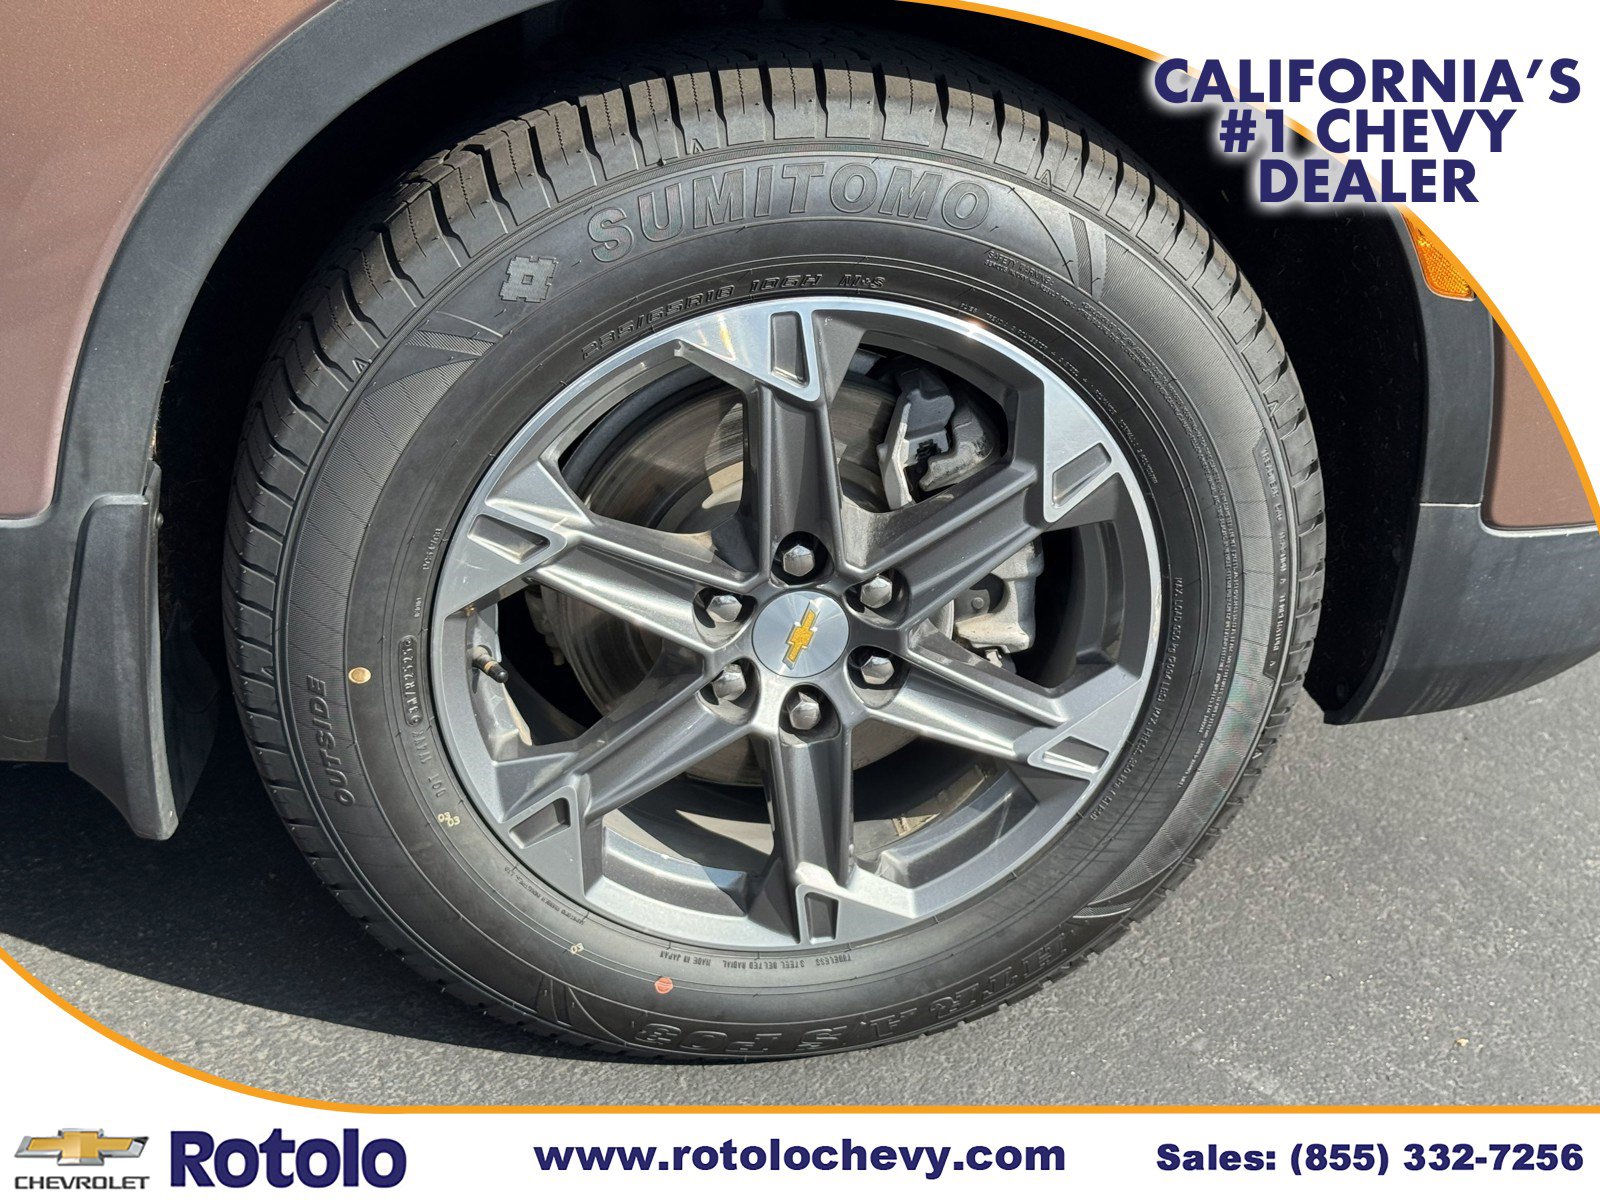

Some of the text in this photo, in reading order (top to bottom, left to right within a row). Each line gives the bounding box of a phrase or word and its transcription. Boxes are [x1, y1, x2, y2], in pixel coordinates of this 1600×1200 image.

[587, 162, 990, 263] SUMITOMO
[580, 273, 886, 361] 235/65R18 106H M+S
[307, 675, 356, 806] OUTSIDE
[658, 949, 712, 967] MADE IN JAPAN
[721, 952, 851, 970] TUBELESS STEEL BELTED RADIAL
